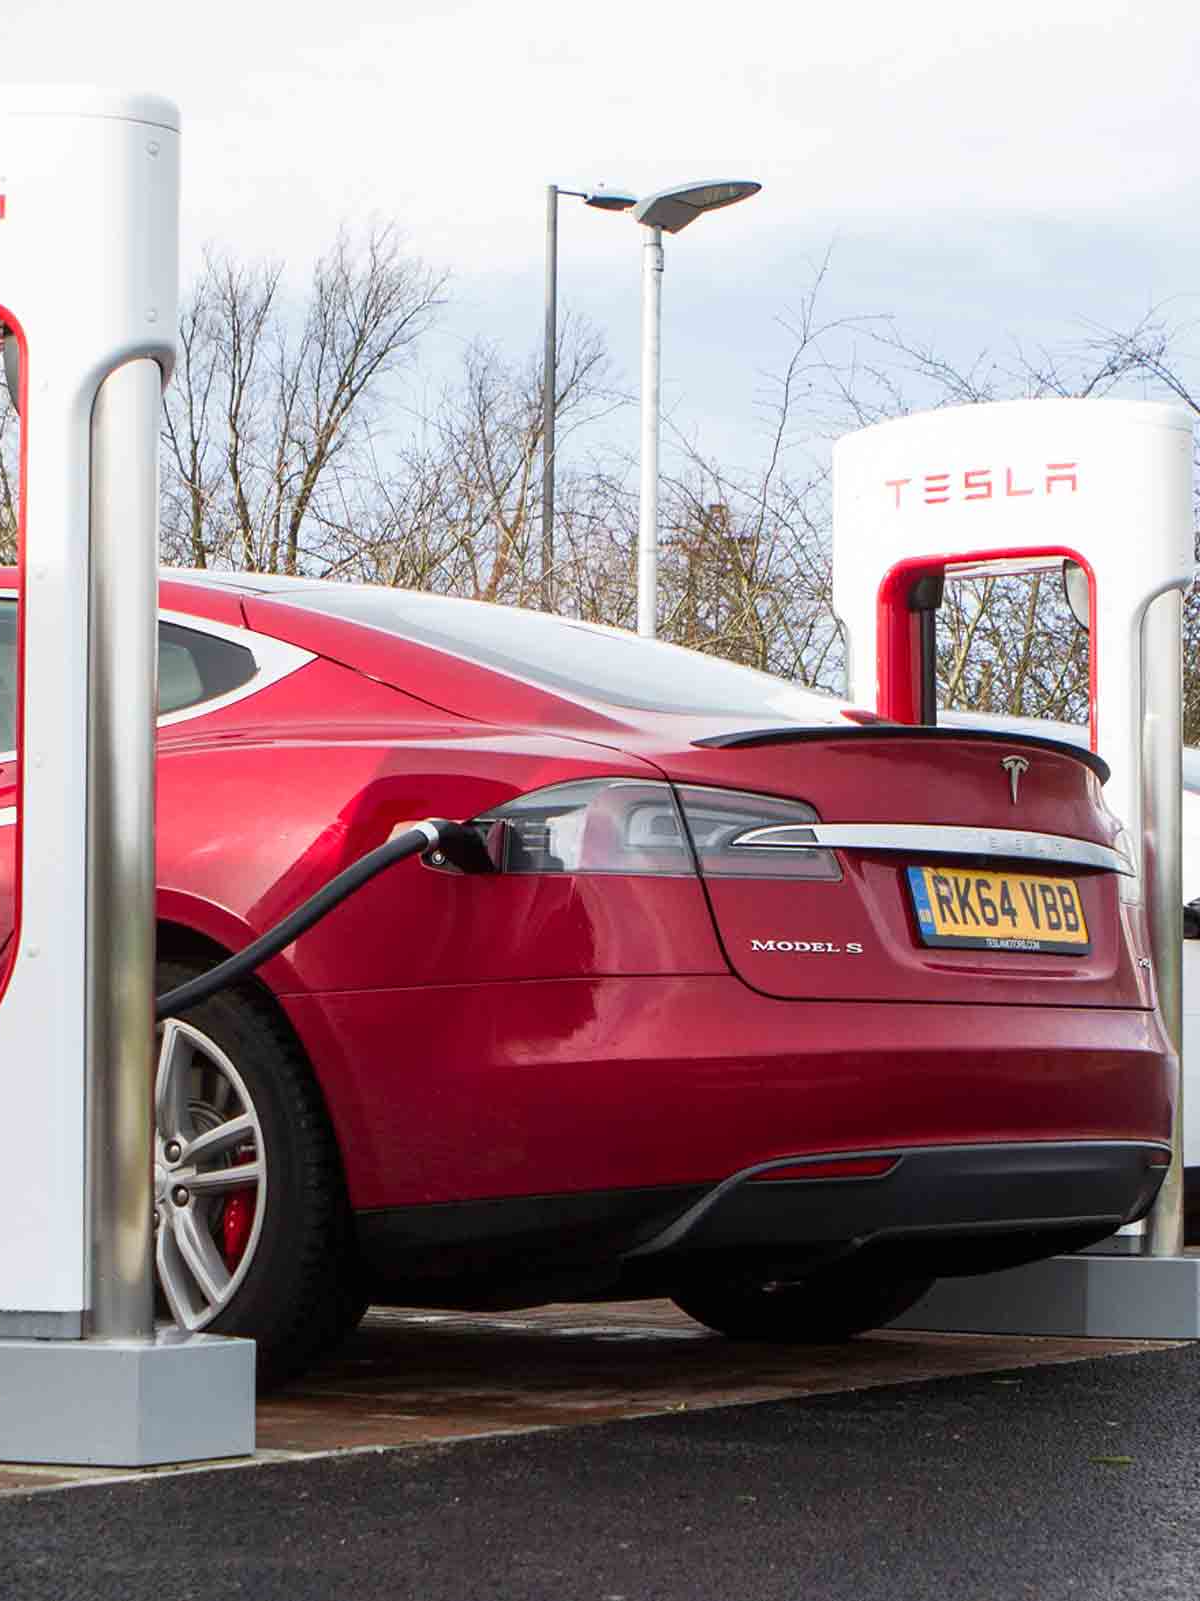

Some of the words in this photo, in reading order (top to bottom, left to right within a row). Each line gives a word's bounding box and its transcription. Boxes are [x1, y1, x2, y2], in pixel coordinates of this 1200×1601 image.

[885, 462, 1078, 511] TESLA
[932, 875, 1018, 928] RK64
[1020, 881, 1080, 933] VBB
[751, 940, 841, 953] MODEL
[846, 942, 864, 954] S
